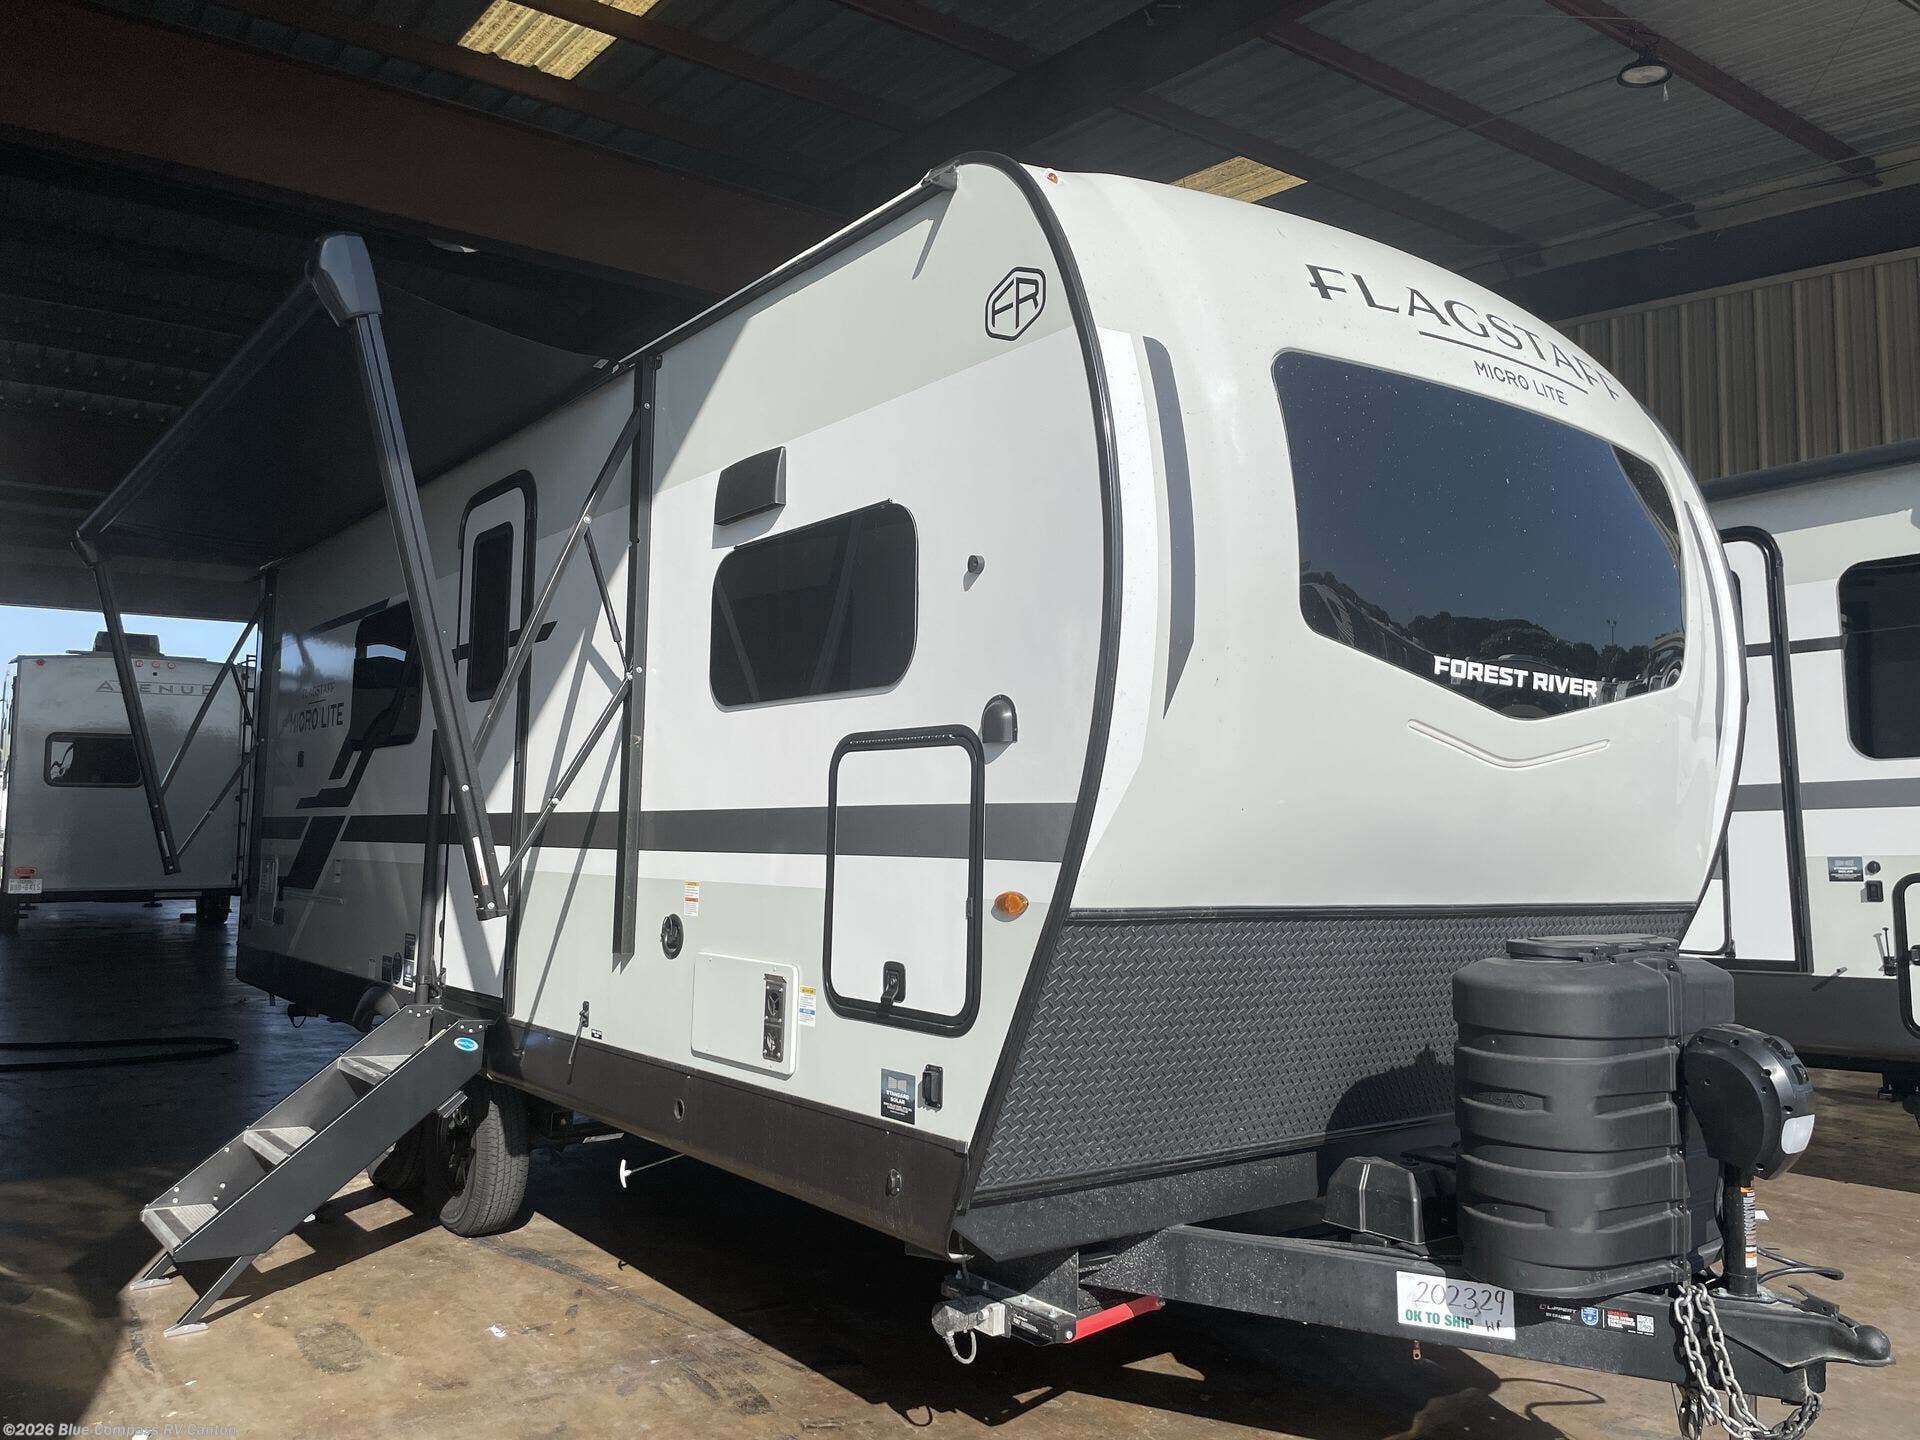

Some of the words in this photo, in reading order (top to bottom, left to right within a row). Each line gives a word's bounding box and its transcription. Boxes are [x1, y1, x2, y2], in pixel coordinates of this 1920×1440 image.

[1305, 263, 1620, 400] FLAGSTAFF
[1474, 360, 1529, 391] MICRO
[1532, 379, 1569, 406] LITE
[96, 680, 213, 696] AENUE
[1433, 655, 1529, 688] FOREST
[1532, 671, 1598, 699] RIVER
[290, 707, 318, 733] MICRO
[320, 703, 344, 728] LITE
[1490, 1092, 1525, 1110] GAS
[1405, 1309, 1422, 1322] OK
[1425, 1311, 1440, 1325] TO
[1444, 1314, 1474, 1329] SHIP
